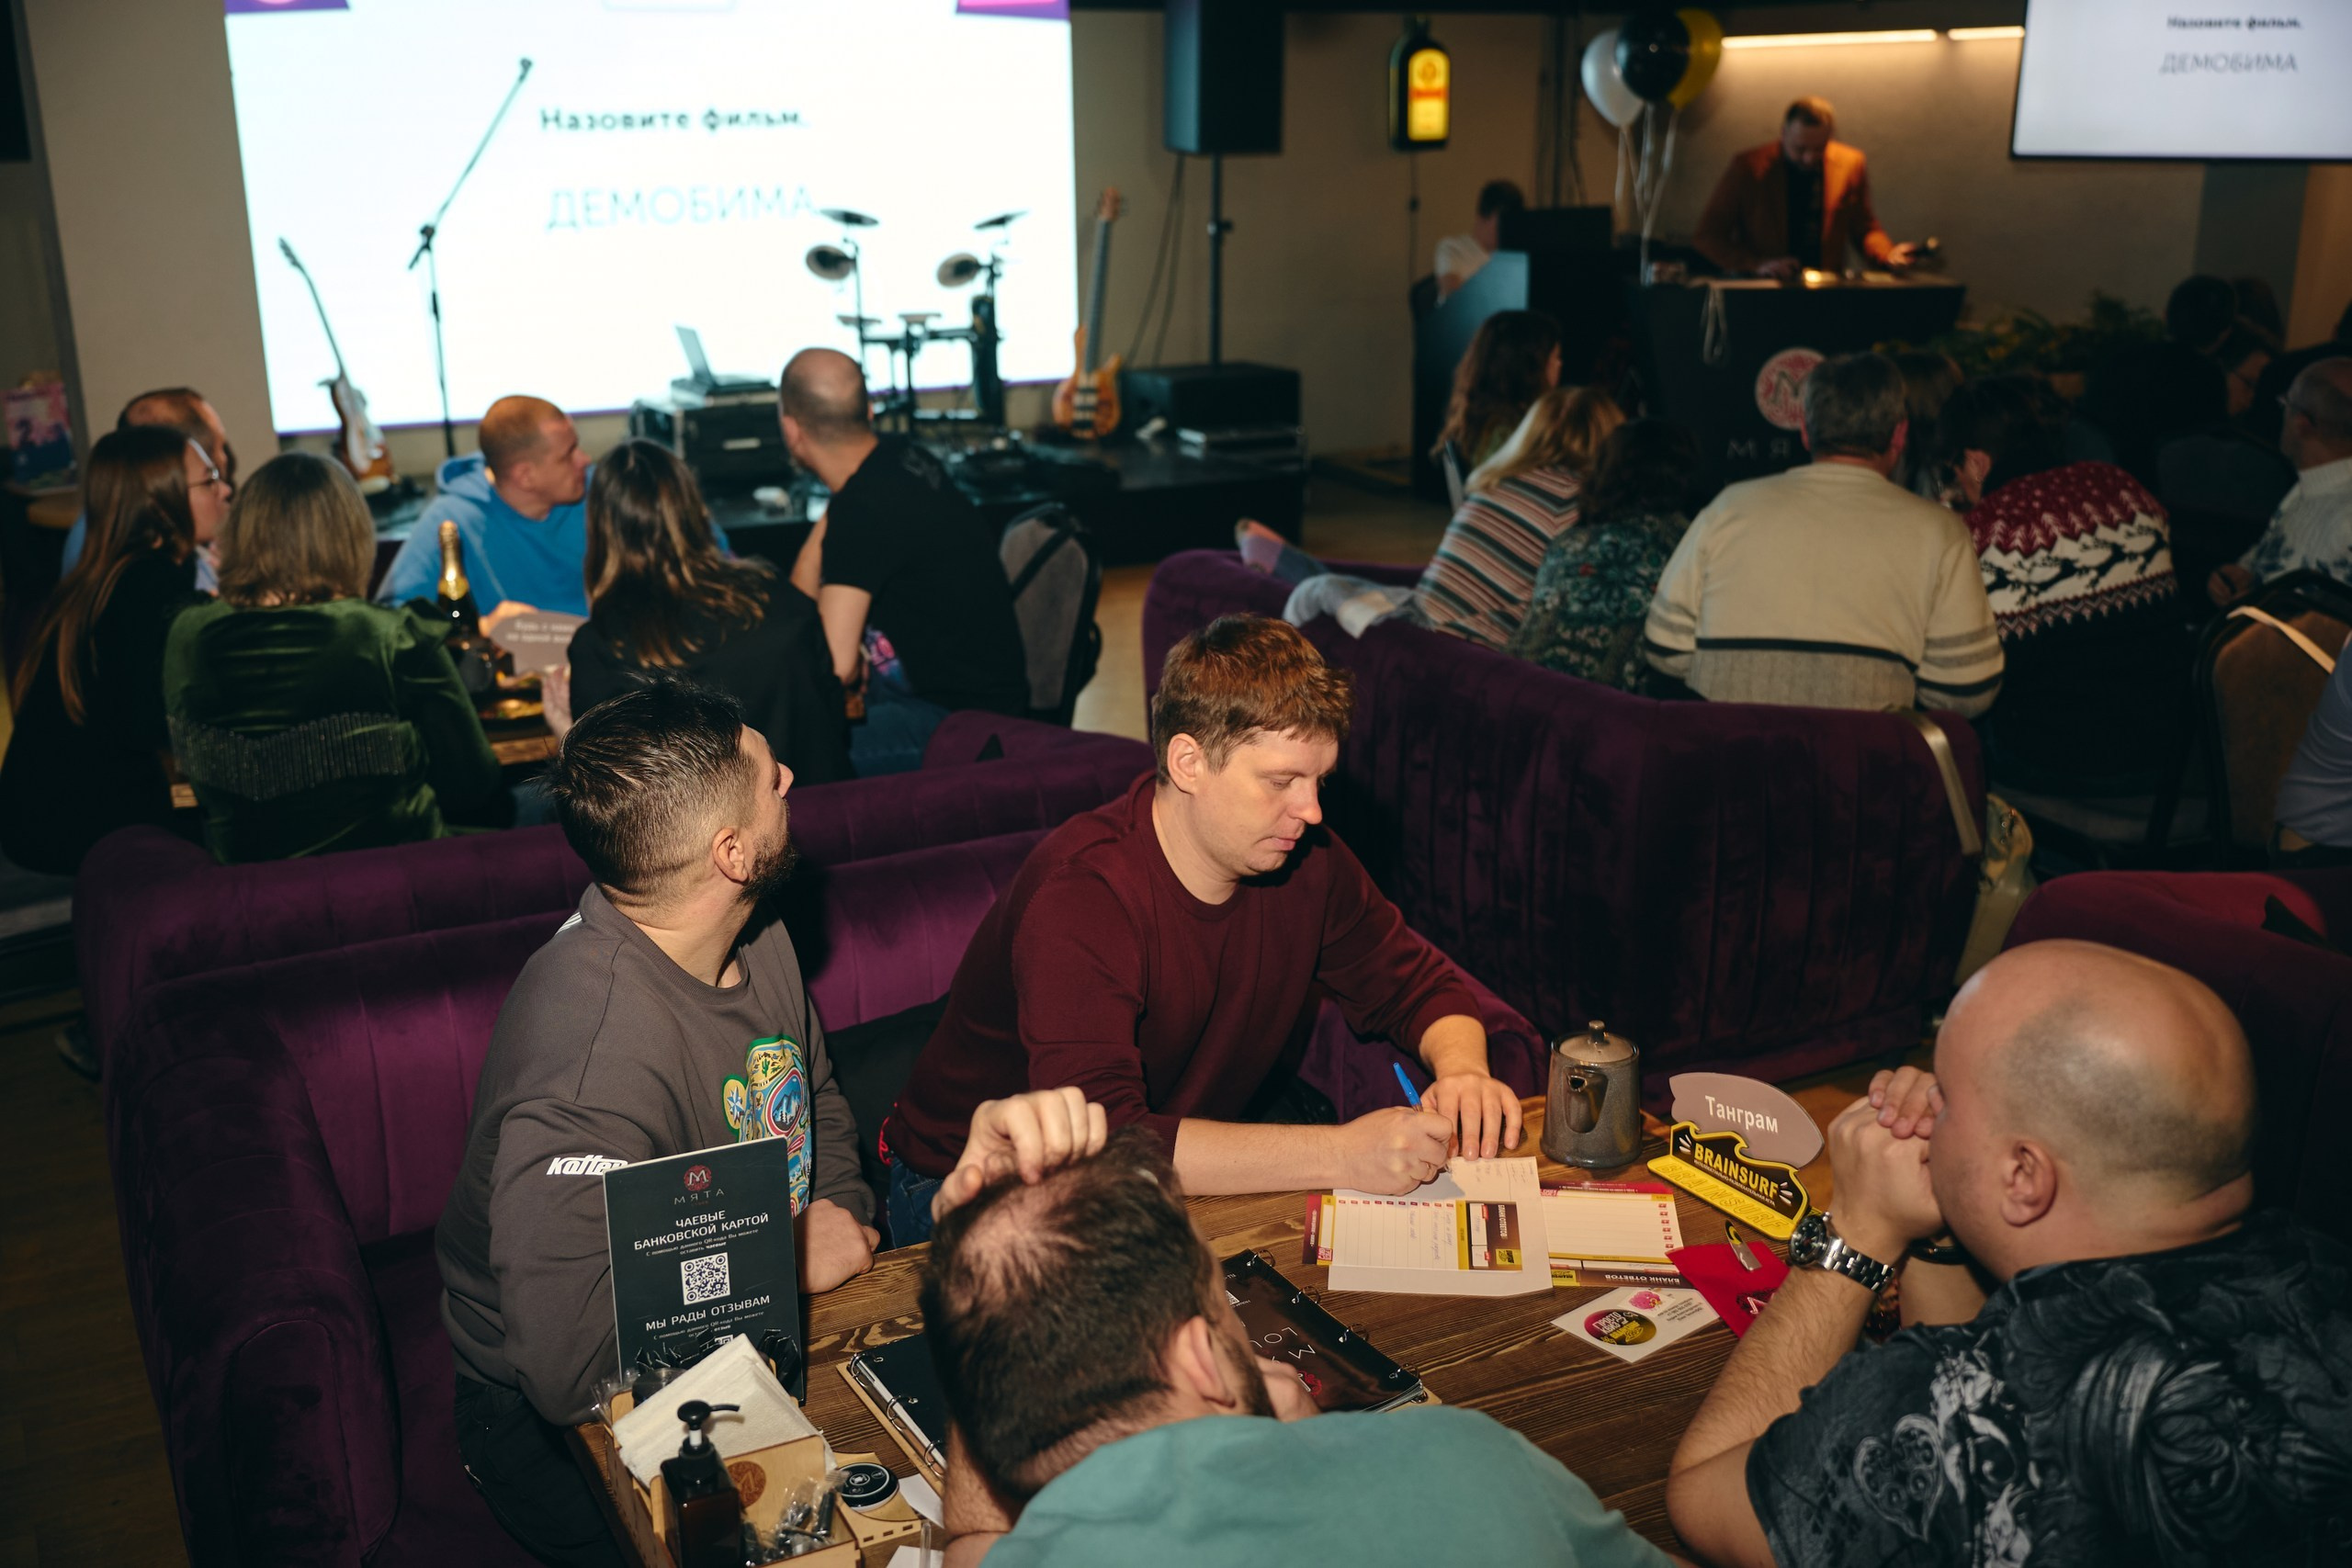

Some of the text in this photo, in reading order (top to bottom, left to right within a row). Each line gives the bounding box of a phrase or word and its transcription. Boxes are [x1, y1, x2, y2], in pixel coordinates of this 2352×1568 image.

[2159, 51, 2299, 74] ДЕМОБИМА
[540, 107, 690, 130] Назовите
[546, 186, 817, 232] ДЕМОБИМА
[1705, 1095, 1779, 1134] Танграм
[1694, 1143, 1779, 1198] BRAINSURF
[673, 1188, 725, 1205] МЯТА
[675, 1210, 726, 1229] ЧАЕВЫЕ
[634, 1213, 769, 1250] БАНКОВСКОЙ КАРТОЙ
[706, 1241, 727, 1249] чаевые
[1605, 1274, 1647, 1282] ОТВЕТОВ
[646, 1294, 770, 1331] МЫ РАДЫ ОТЗЫВАМ
